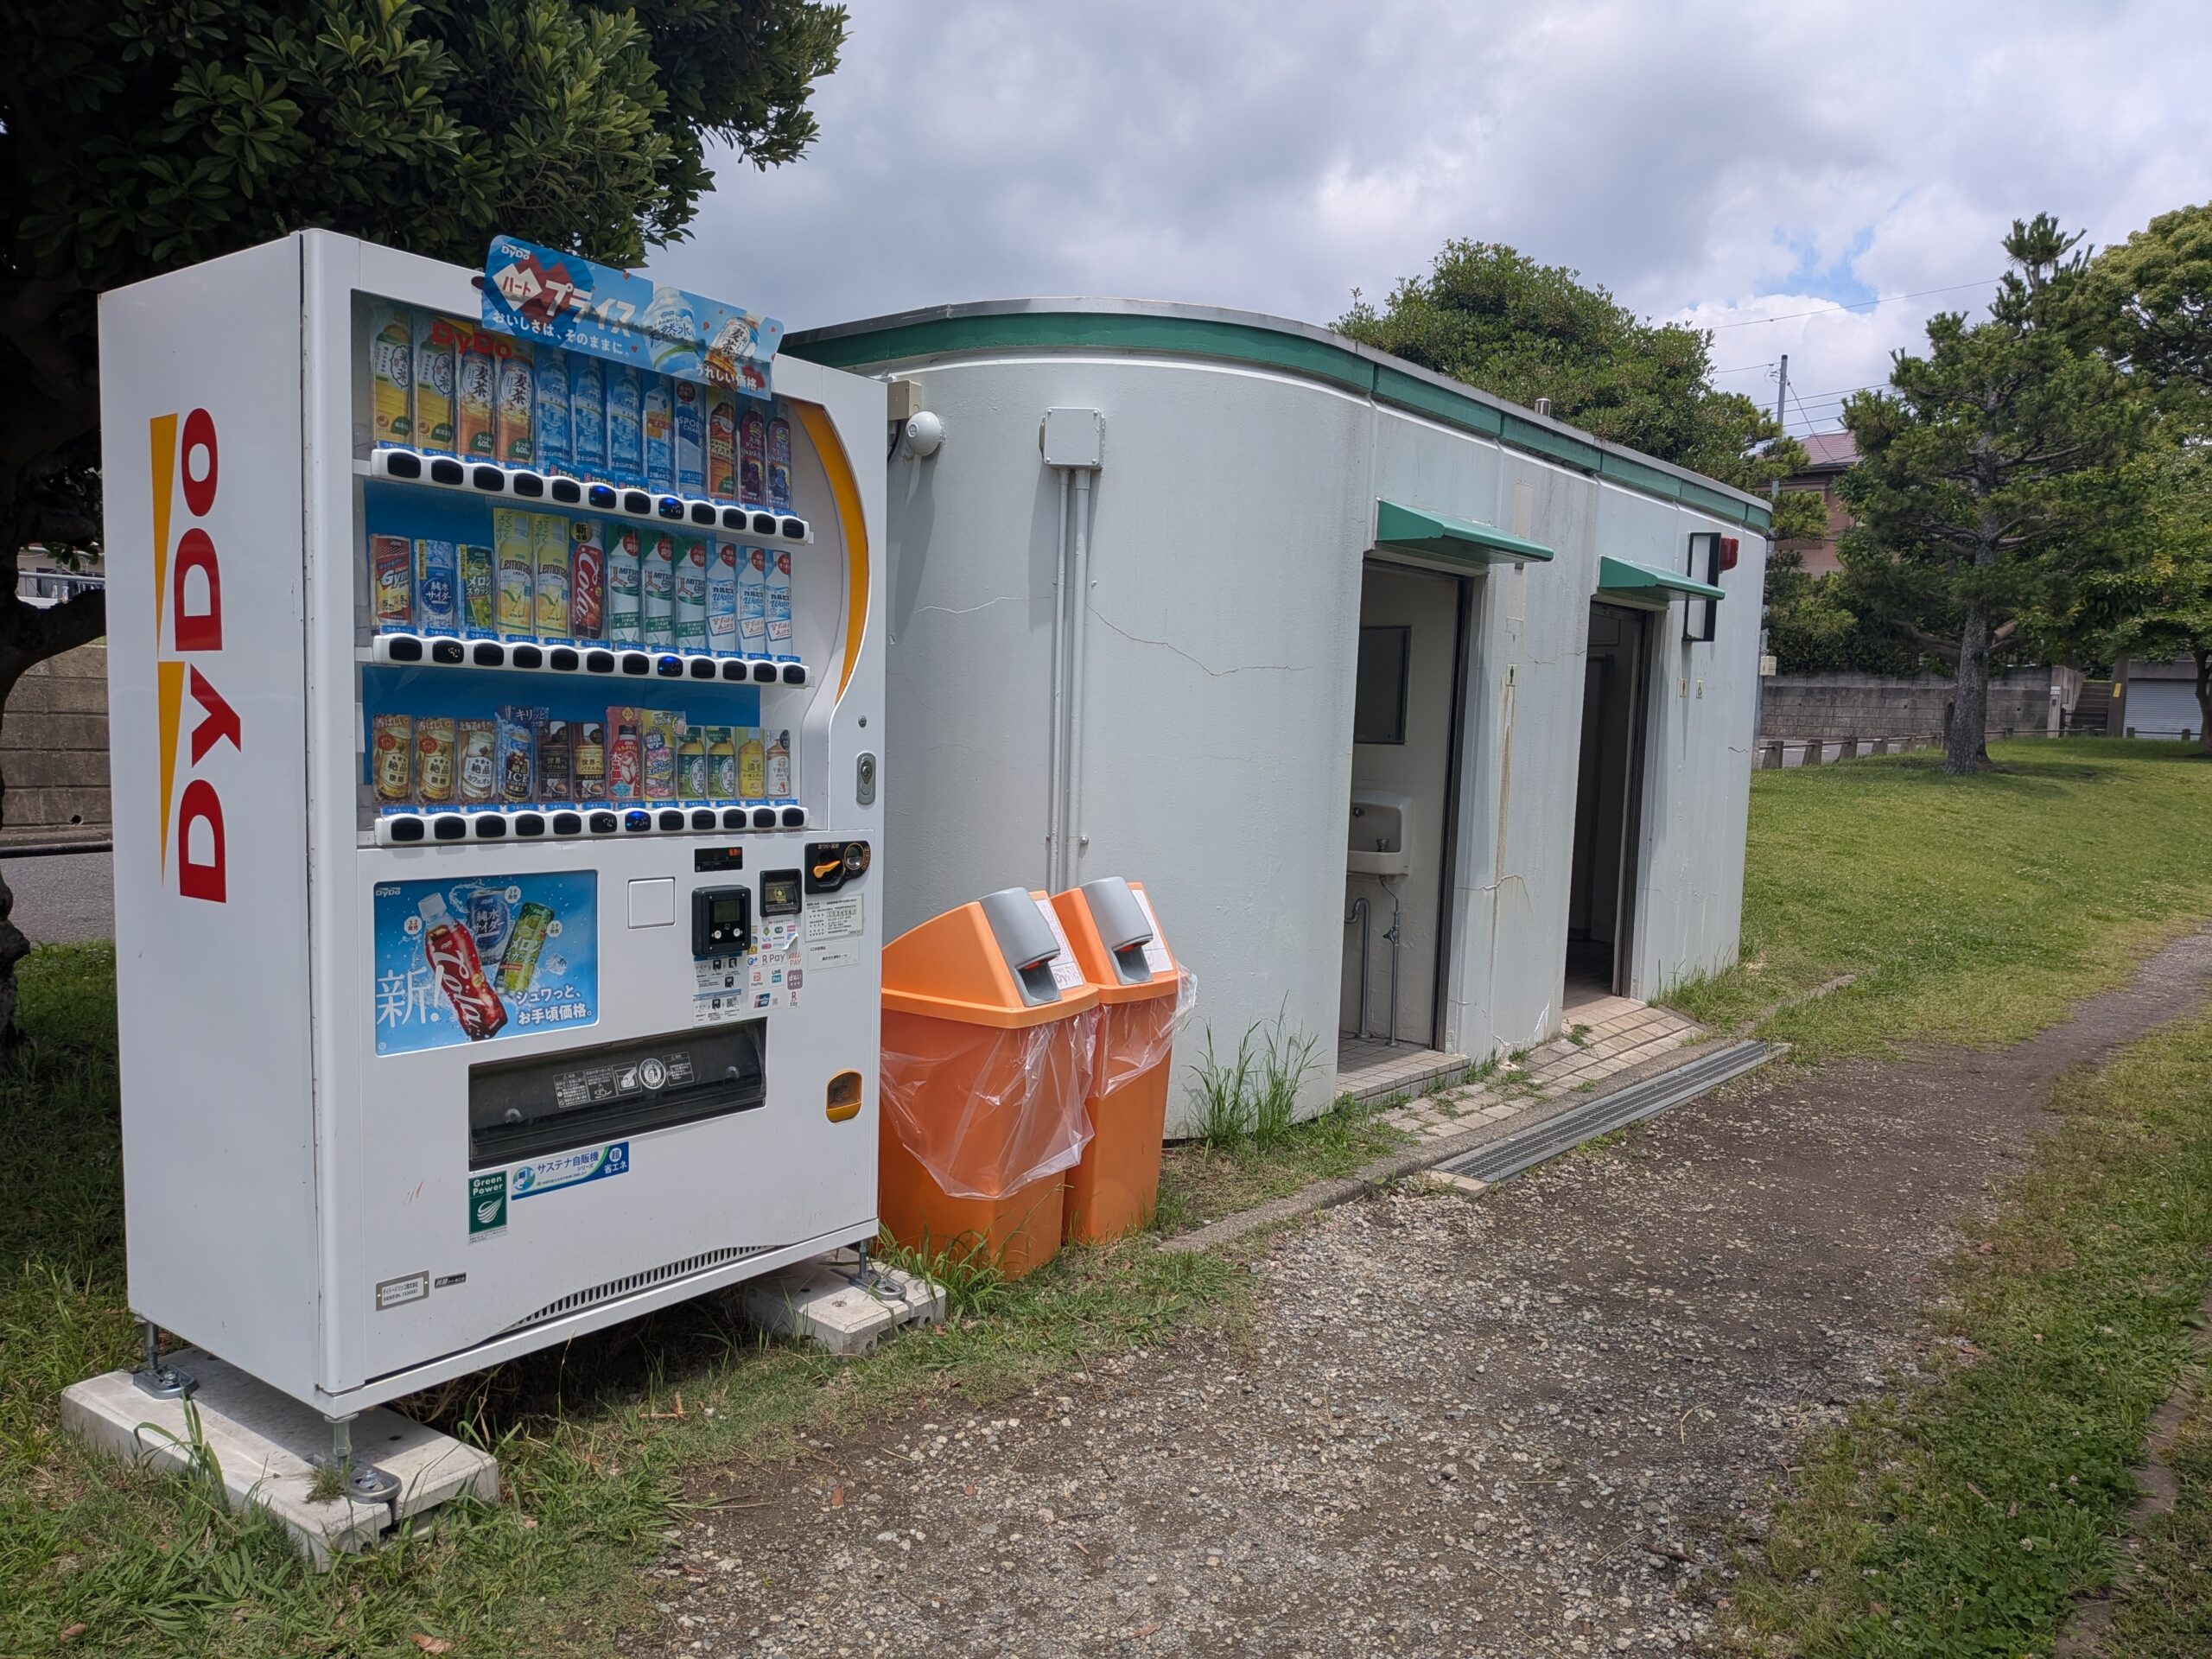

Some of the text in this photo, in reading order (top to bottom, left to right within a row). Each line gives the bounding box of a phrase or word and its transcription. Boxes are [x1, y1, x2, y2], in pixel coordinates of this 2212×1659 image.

[501, 245, 531, 260] DyDo
[501, 276, 637, 338] ハート プライス
[431, 321, 512, 360] DyDo
[492, 311, 630, 359] おいしさは、そのままに。
[472, 365, 489, 398] 麦茶
[696, 362, 762, 393] うれしい価格。
[511, 372, 528, 405] 麦茶
[575, 523, 587, 535] 新
[465, 575, 492, 588] メロン
[575, 552, 600, 622] Cola
[425, 591, 452, 601] サイダー
[516, 710, 545, 721] キリッと
[387, 760, 407, 772] 絶品
[429, 762, 449, 774] 絶品
[471, 762, 491, 774] 絶品
[506, 771, 529, 783] ICE
[375, 887, 401, 898] DyDo
[476, 908, 499, 922] 純水
[473, 918, 505, 933] サイダー
[512, 936, 541, 953] メロン
[503, 951, 536, 963] スカッシュ
[769, 953, 785, 963] Pay
[434, 950, 486, 1027] Cola
[516, 985, 582, 1005] シュワっと、
[518, 1001, 594, 1027] お手頃価格。
[537, 1151, 600, 1175] サステナ自販機
[576, 1163, 594, 1173] シリーズ
[603, 1160, 628, 1175] 省エネ
[473, 1176, 503, 1188] Green
[473, 1183, 504, 1197] Power
